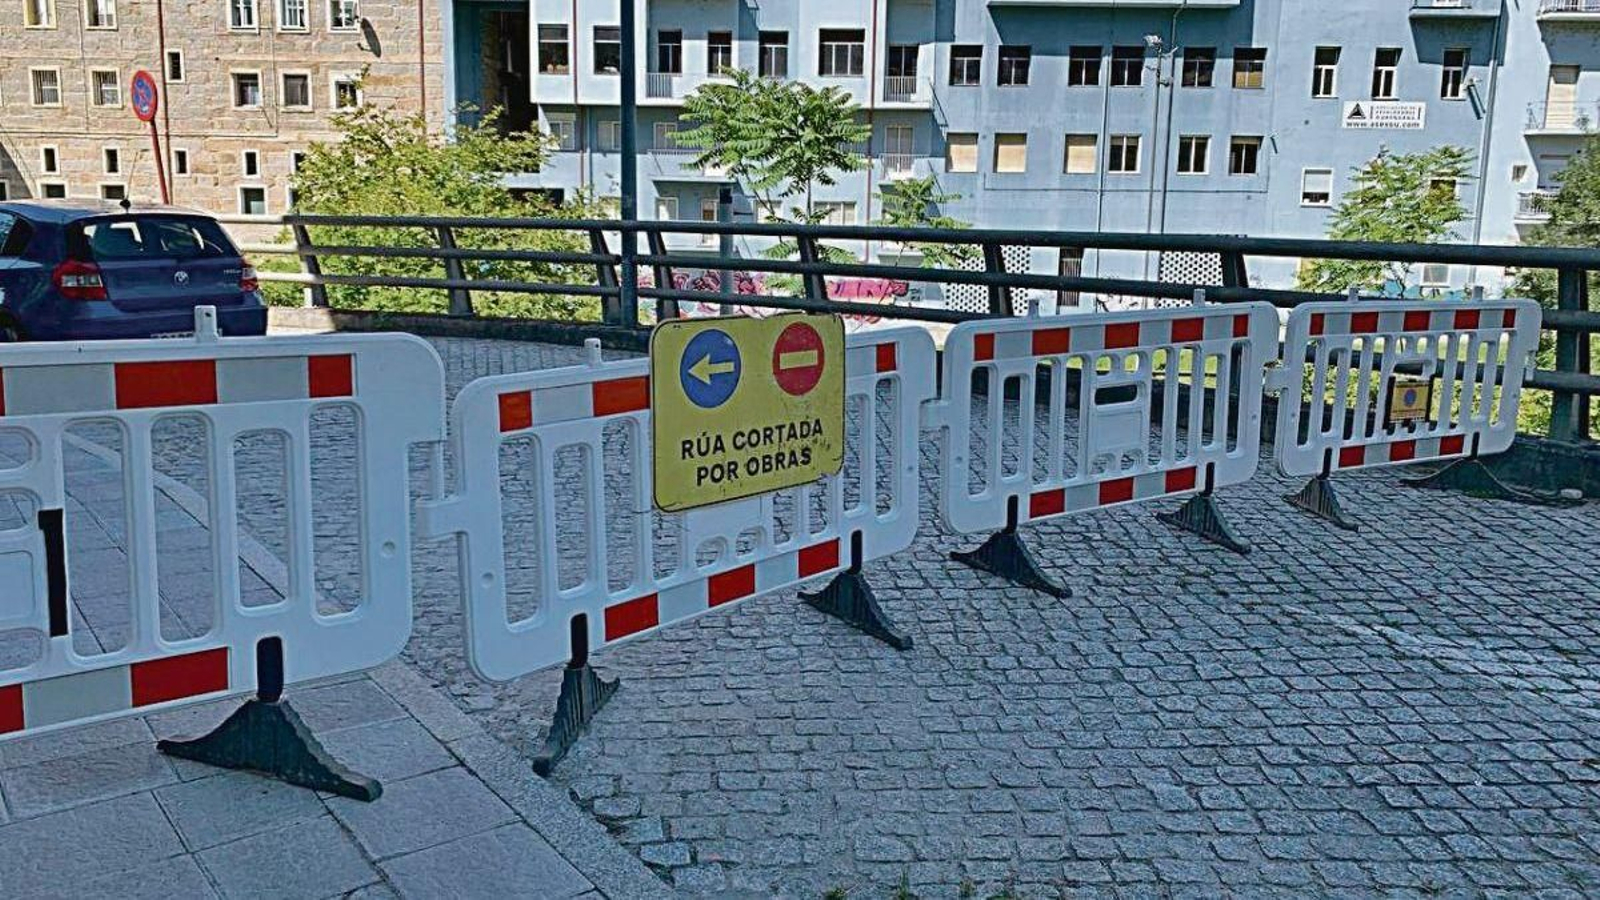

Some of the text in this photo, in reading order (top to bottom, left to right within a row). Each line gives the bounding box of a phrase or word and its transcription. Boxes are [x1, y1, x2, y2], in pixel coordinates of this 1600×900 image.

[681, 418, 823, 460] RÚA CORTADA
[696, 448, 812, 486] POR OBRAS
